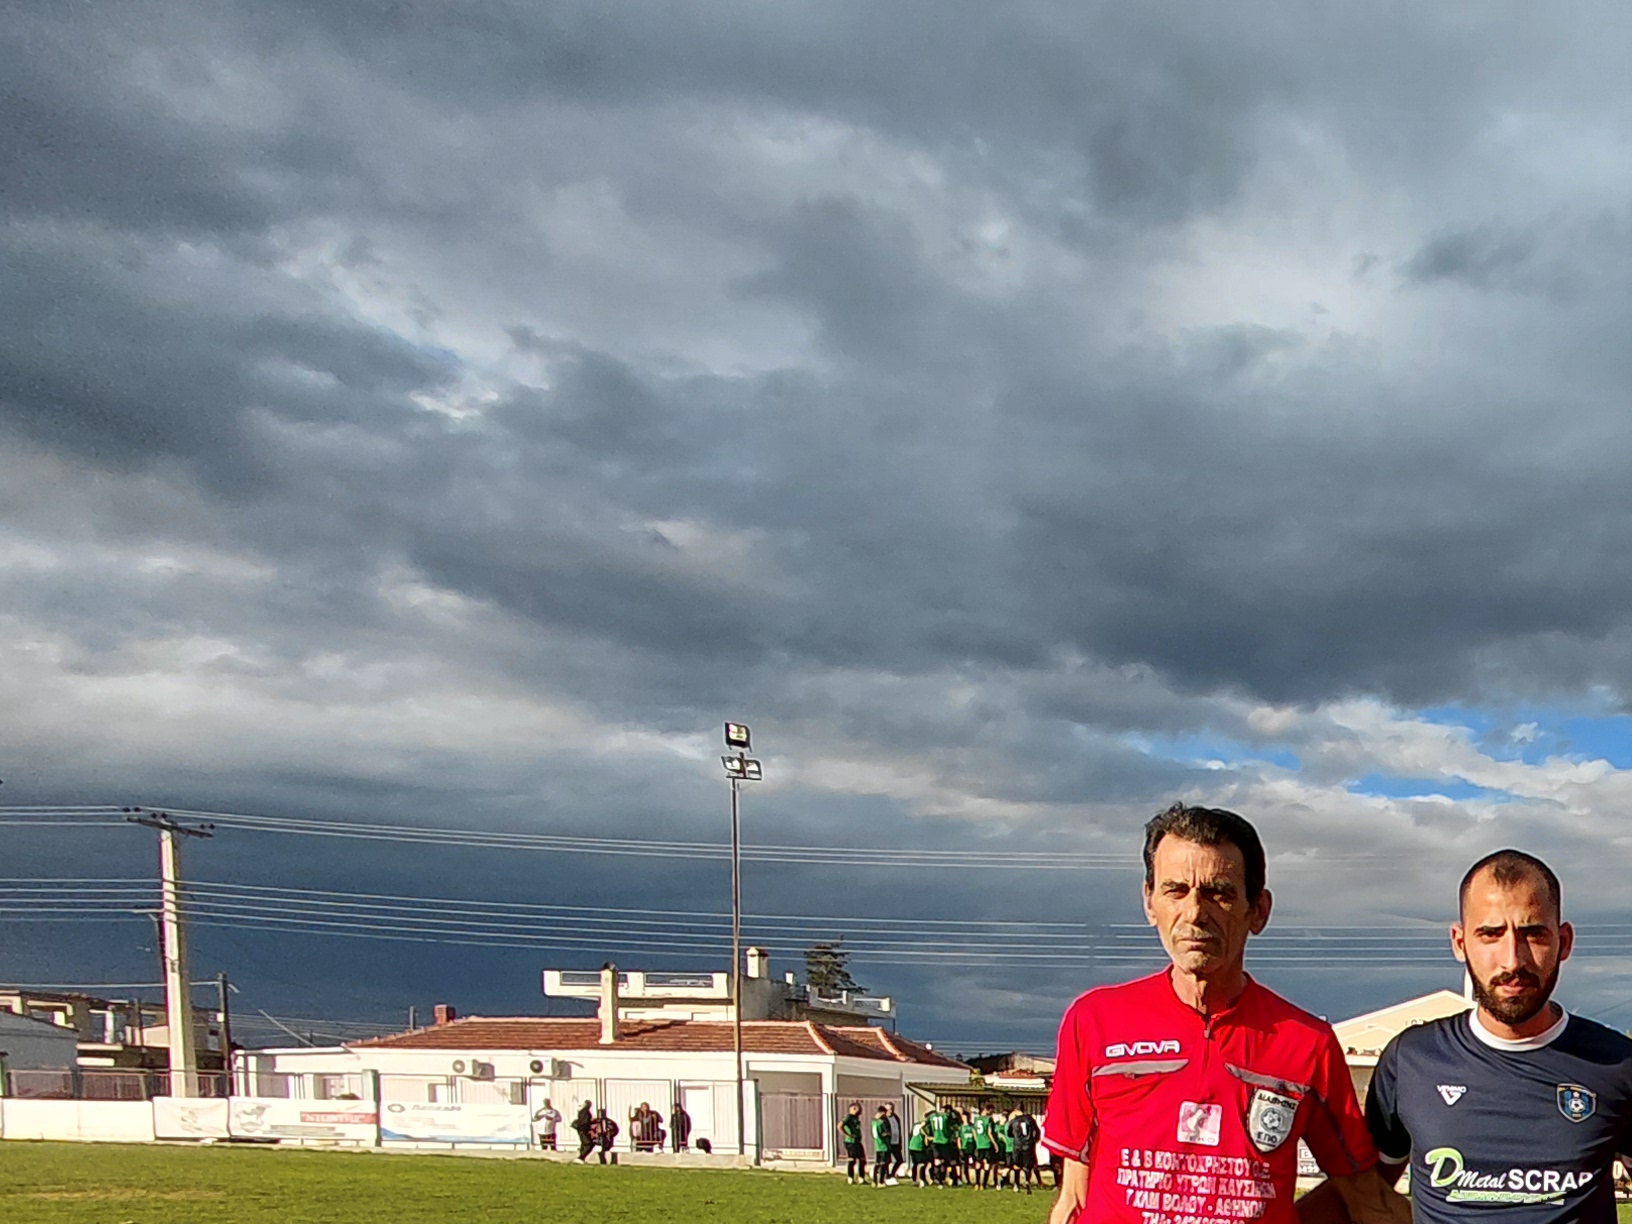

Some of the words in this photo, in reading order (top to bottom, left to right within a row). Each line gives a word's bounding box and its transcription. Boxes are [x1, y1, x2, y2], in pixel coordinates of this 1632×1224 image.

[1105, 1040, 1180, 1058] GIVOVA
[933, 1115, 943, 1131] 11
[976, 1120, 984, 1135] 5
[1020, 1122, 1028, 1136] 1
[1131, 1149, 1141, 1168] &
[1117, 1168, 1173, 1192] ΠΡΑΤΗΡΙΟ
[1176, 1174, 1216, 1196] ΥΓΡΩΝ
[1455, 1170, 1507, 1190] Metal
[1508, 1168, 1594, 1192] SCRAP
[1162, 1193, 1206, 1214] ΒΟΛΟΥ
